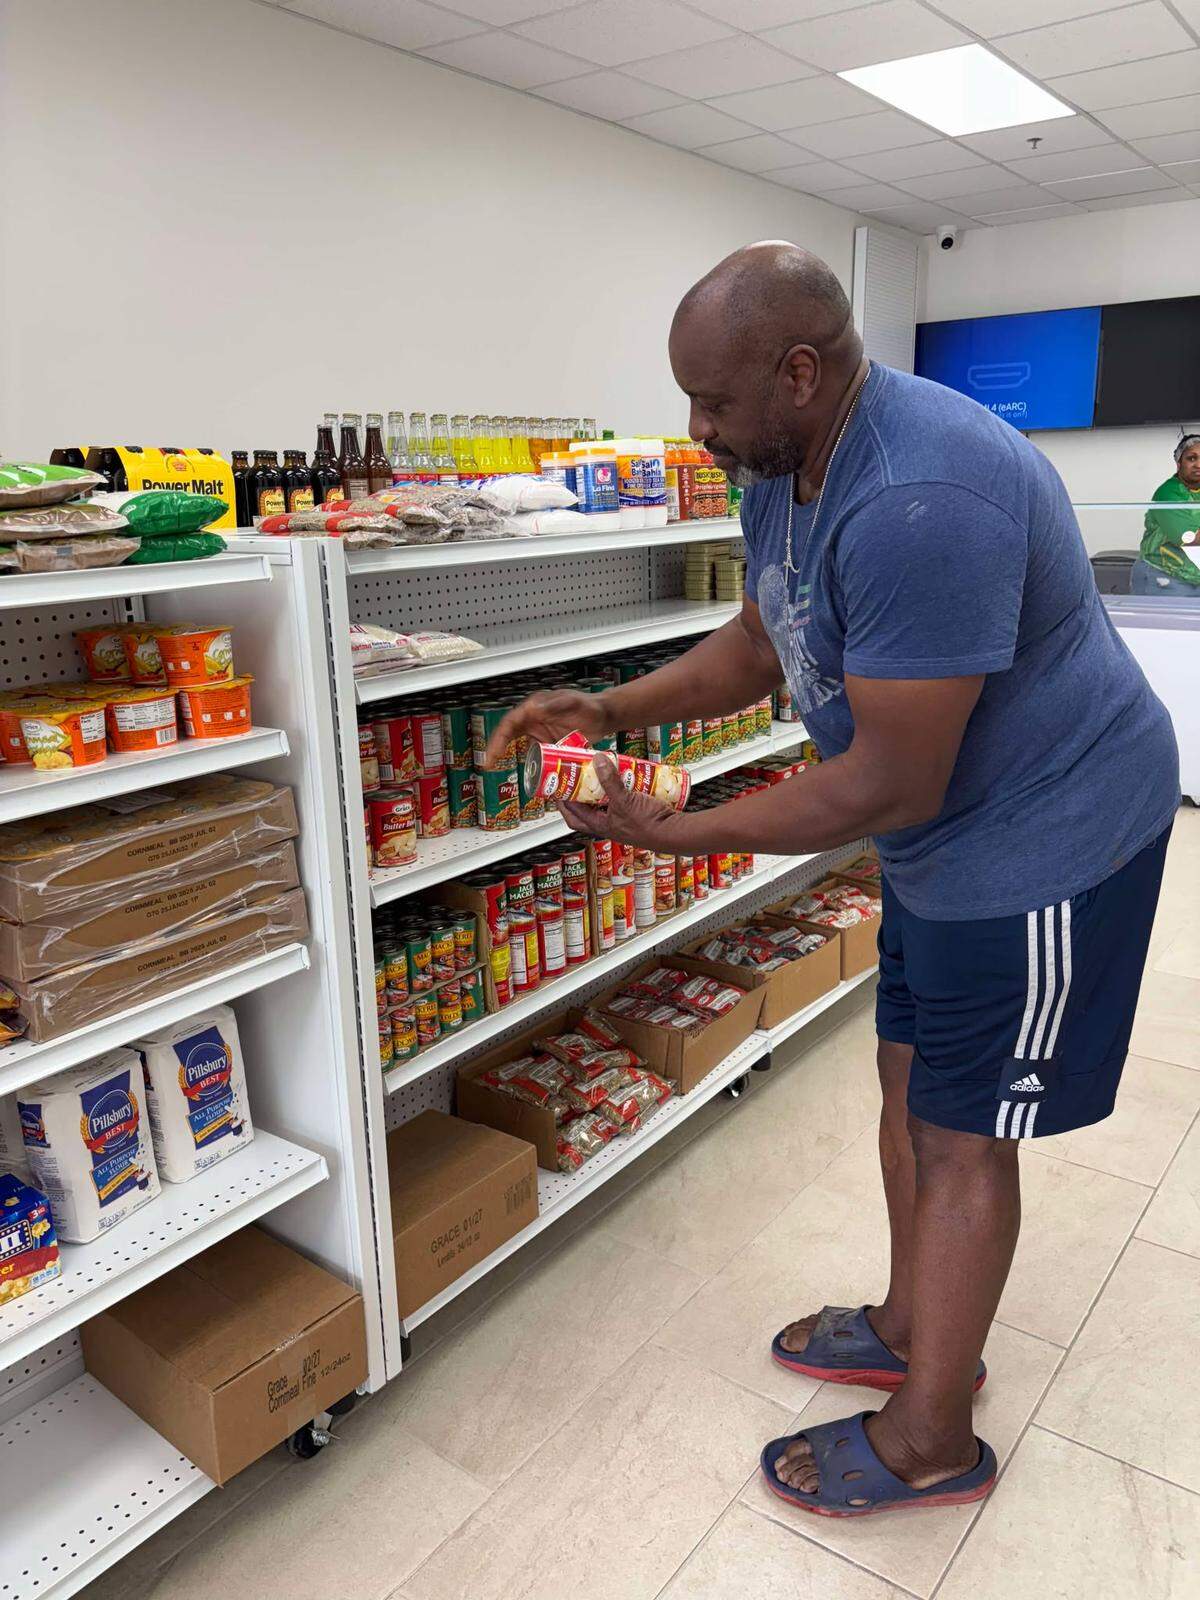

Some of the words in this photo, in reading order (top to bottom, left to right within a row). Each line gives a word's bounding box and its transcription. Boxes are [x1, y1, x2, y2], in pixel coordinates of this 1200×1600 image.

[191, 479, 224, 495] Malt
[546, 775, 557, 794] Grace
[383, 823, 405, 831] Butter
[187, 1055, 227, 1082] Pillsbury
[200, 1073, 221, 1089] BEST
[1009, 1084, 1045, 1092] adidas
[92, 1102, 131, 1133] Pillsbury
[193, 1109, 206, 1122] ALL
[105, 1123, 126, 1140] BEST
[97, 1165, 109, 1177] ALL
[431, 1224, 460, 1253] GRACE
[267, 1375, 288, 1397] Grace
[268, 1380, 300, 1413] Cornmeal
